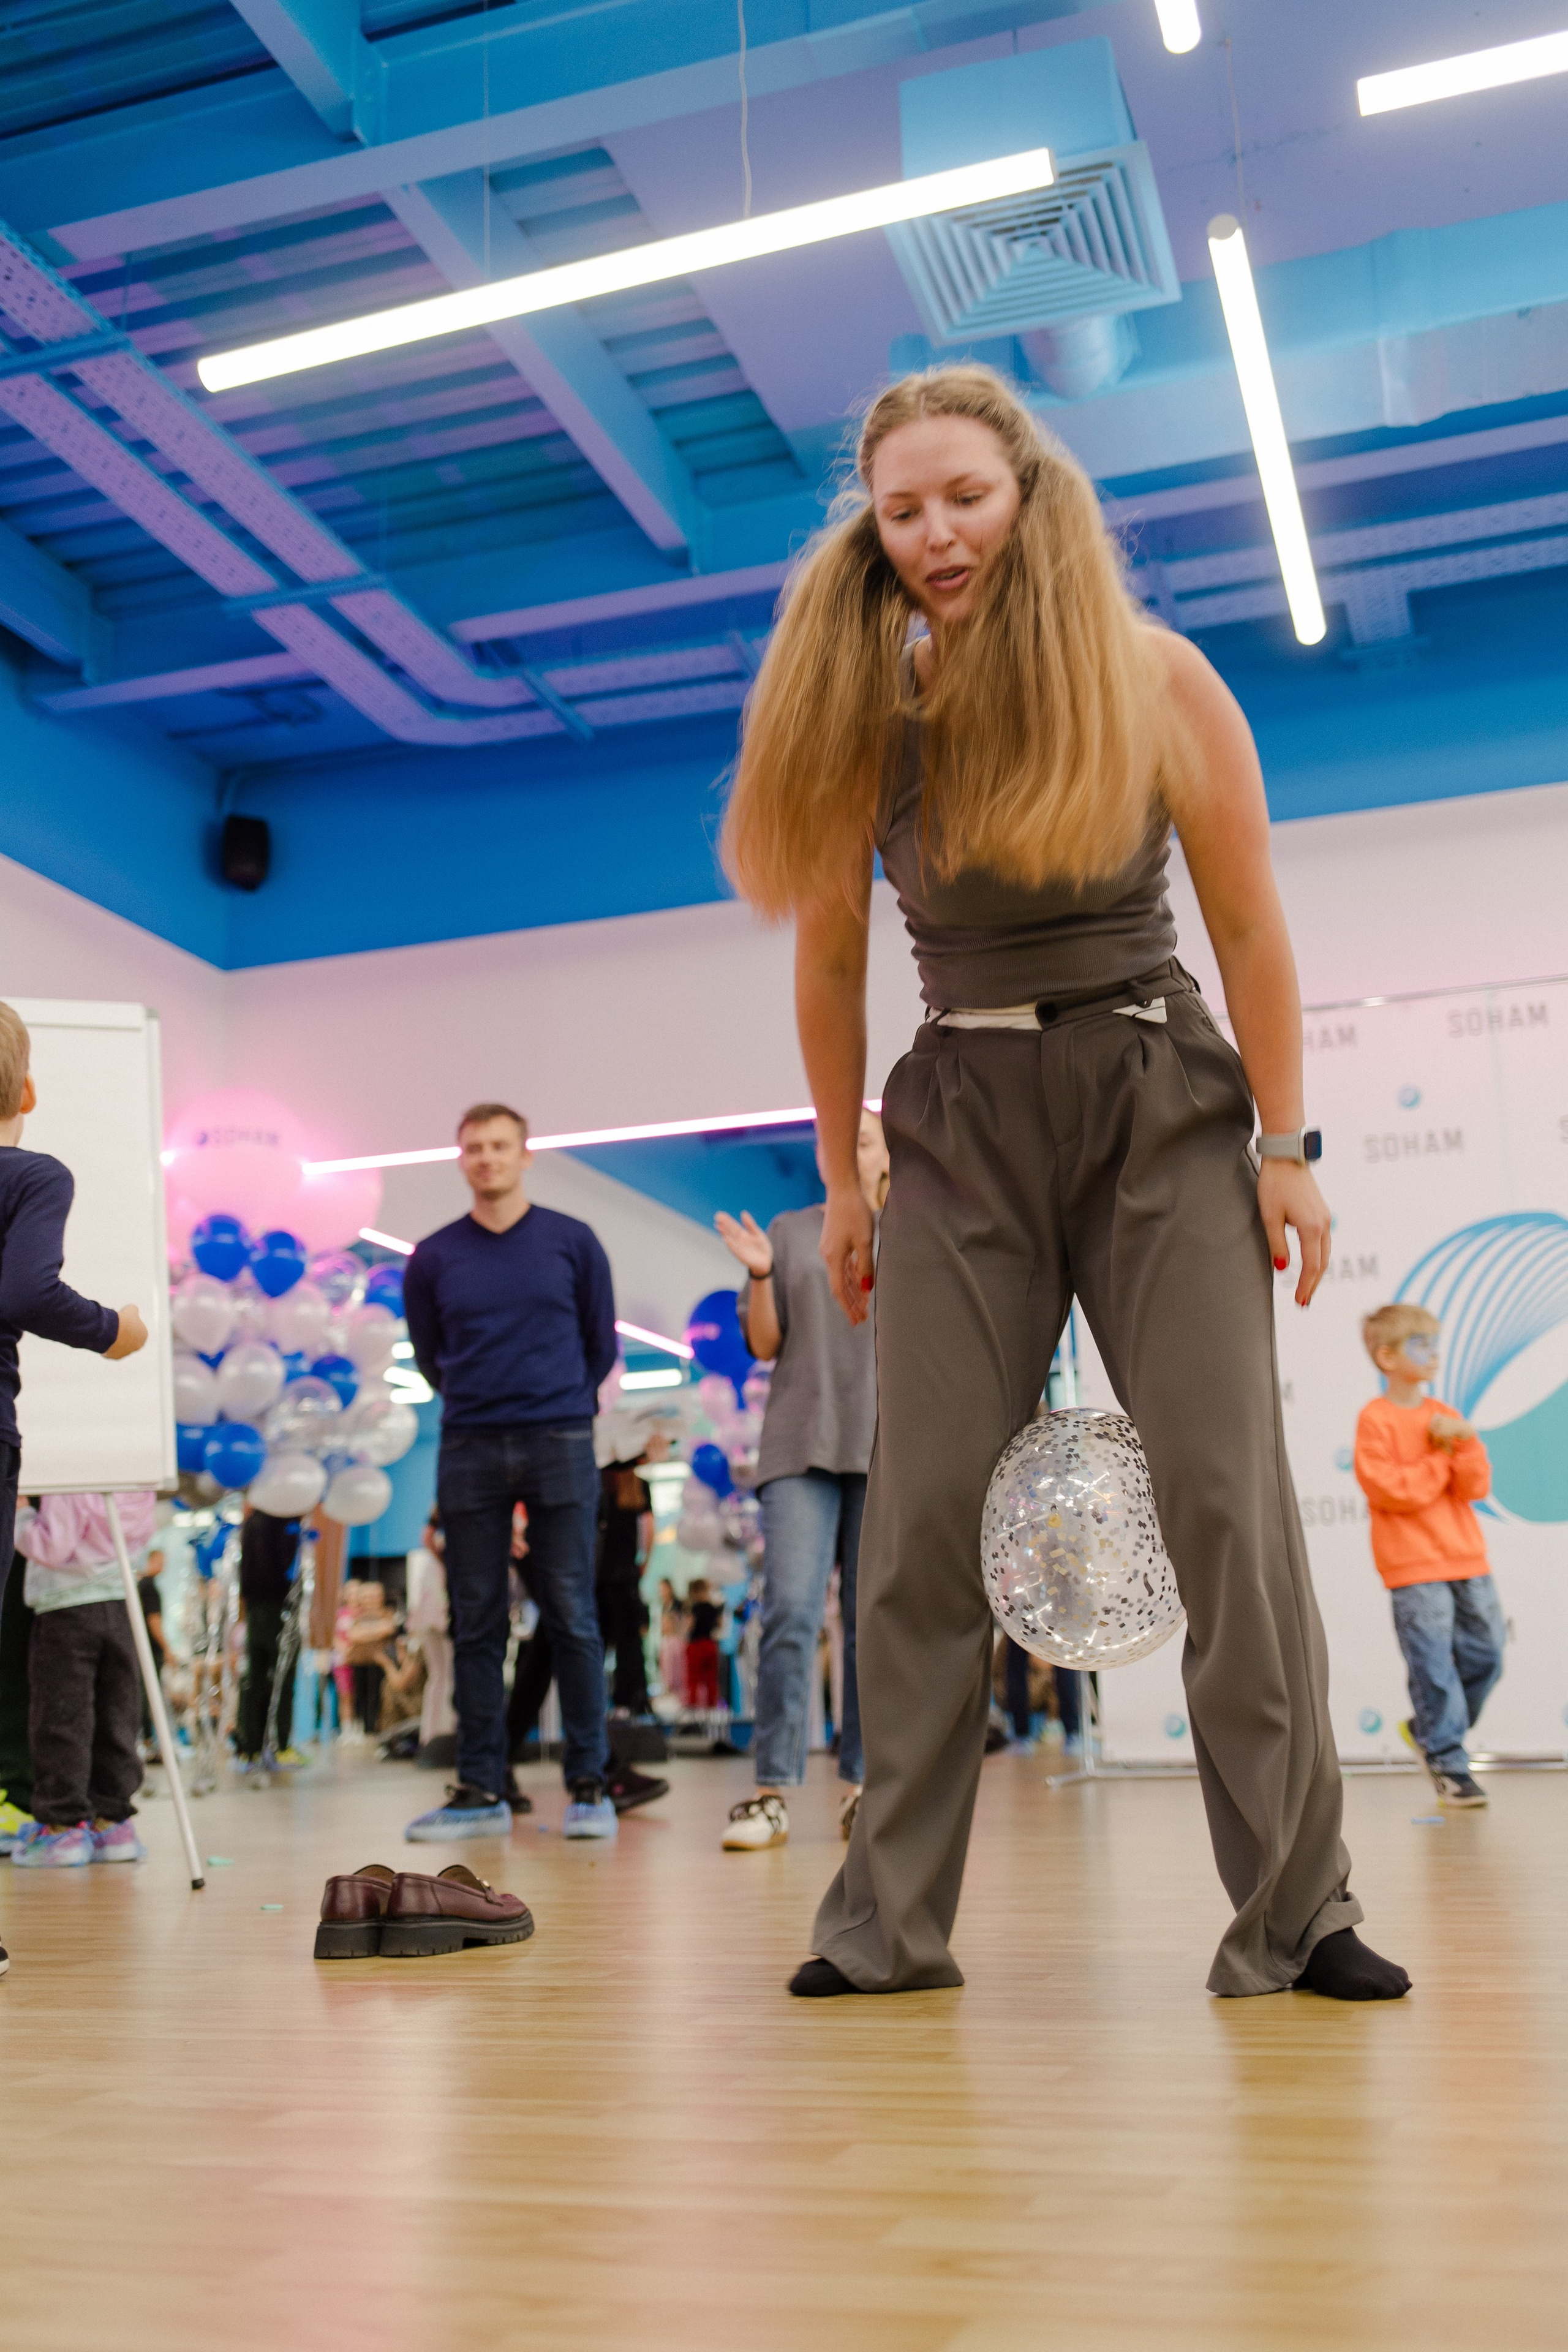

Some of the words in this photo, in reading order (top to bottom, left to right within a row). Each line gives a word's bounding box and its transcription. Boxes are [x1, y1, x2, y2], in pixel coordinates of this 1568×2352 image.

[1447, 1002, 1550, 1038] SOHAM
[1302, 1025, 1357, 1051] HAM
[1363, 1128, 1465, 1163] SOHAM
